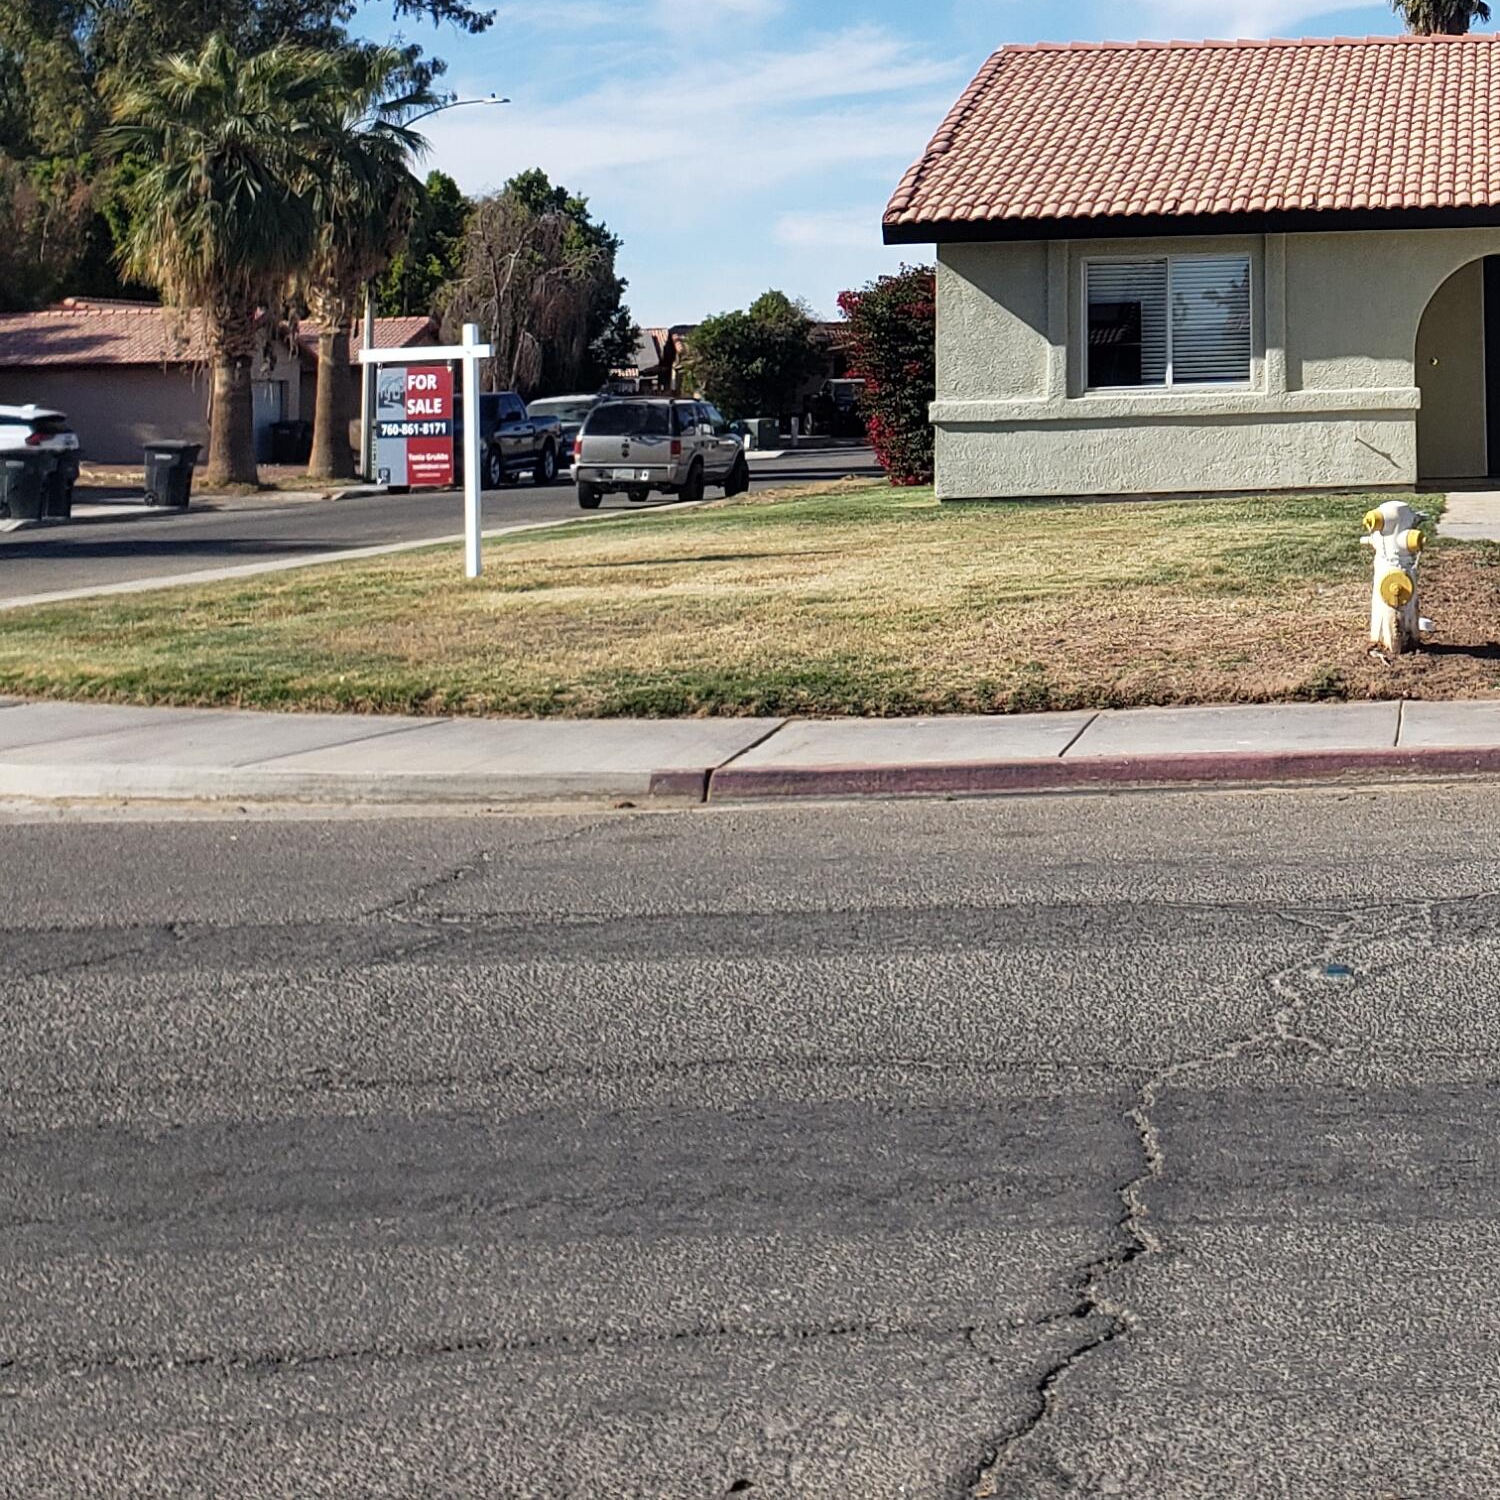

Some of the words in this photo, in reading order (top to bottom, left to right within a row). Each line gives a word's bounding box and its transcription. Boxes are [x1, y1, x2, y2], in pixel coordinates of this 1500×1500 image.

[407, 374, 437, 390] FOR
[407, 398, 442, 415] SALE
[381, 422, 446, 436] 760-861-8171
